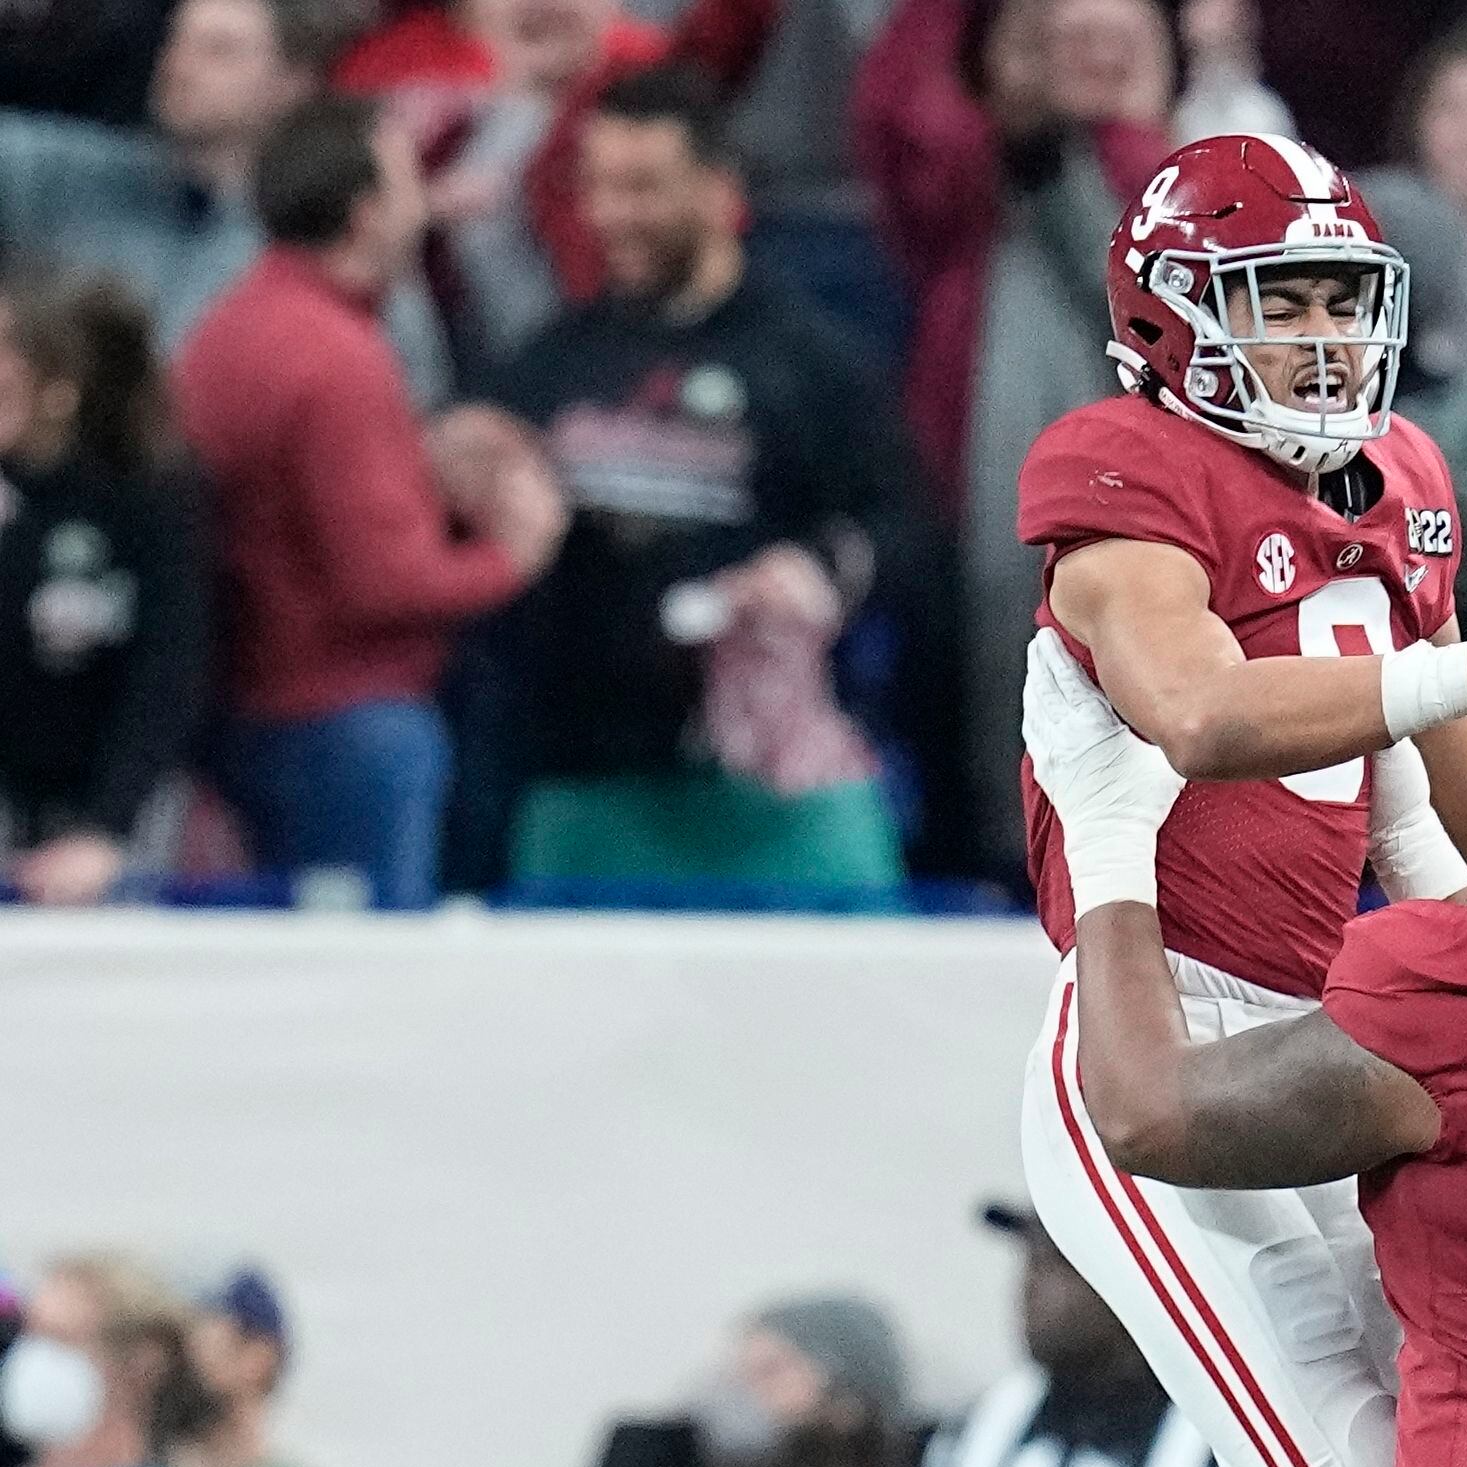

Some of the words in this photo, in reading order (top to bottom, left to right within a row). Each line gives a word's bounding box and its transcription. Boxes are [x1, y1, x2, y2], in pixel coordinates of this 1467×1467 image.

[1131, 165, 1180, 241] 9
[1311, 223, 1355, 238] BAMA
[1256, 533, 1296, 594] SEC
